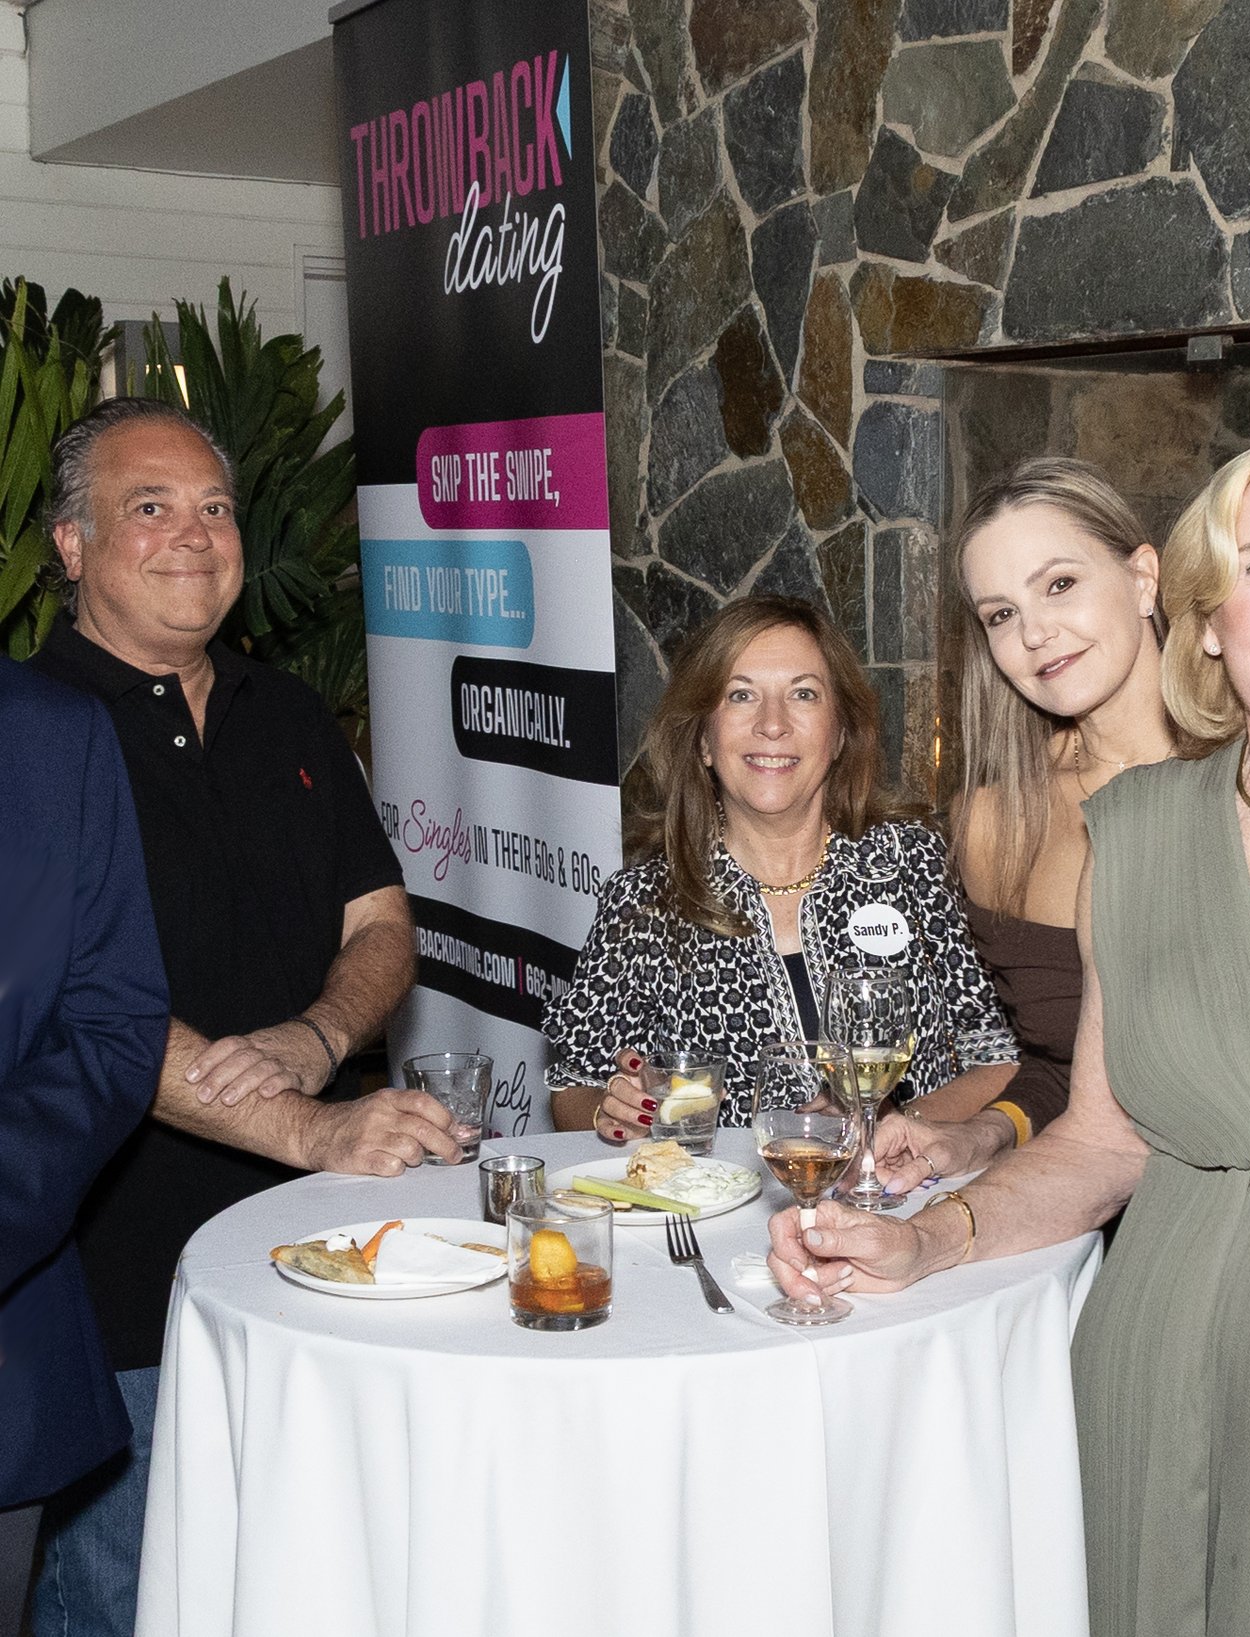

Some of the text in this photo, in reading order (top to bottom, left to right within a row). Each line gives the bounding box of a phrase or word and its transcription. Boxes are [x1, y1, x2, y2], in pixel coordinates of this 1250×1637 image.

[350, 50, 563, 239] THROWBACK
[444, 180, 565, 343] dating
[431, 448, 560, 507] SKIP THE SWIPE,
[384, 565, 526, 619] FIND YOUR TYPE...
[461, 682, 571, 748] ORGANICALLY.
[381, 800, 600, 897] FOR Singles IN THEIR 50s & 60s
[853, 923, 903, 937] Sandy P.
